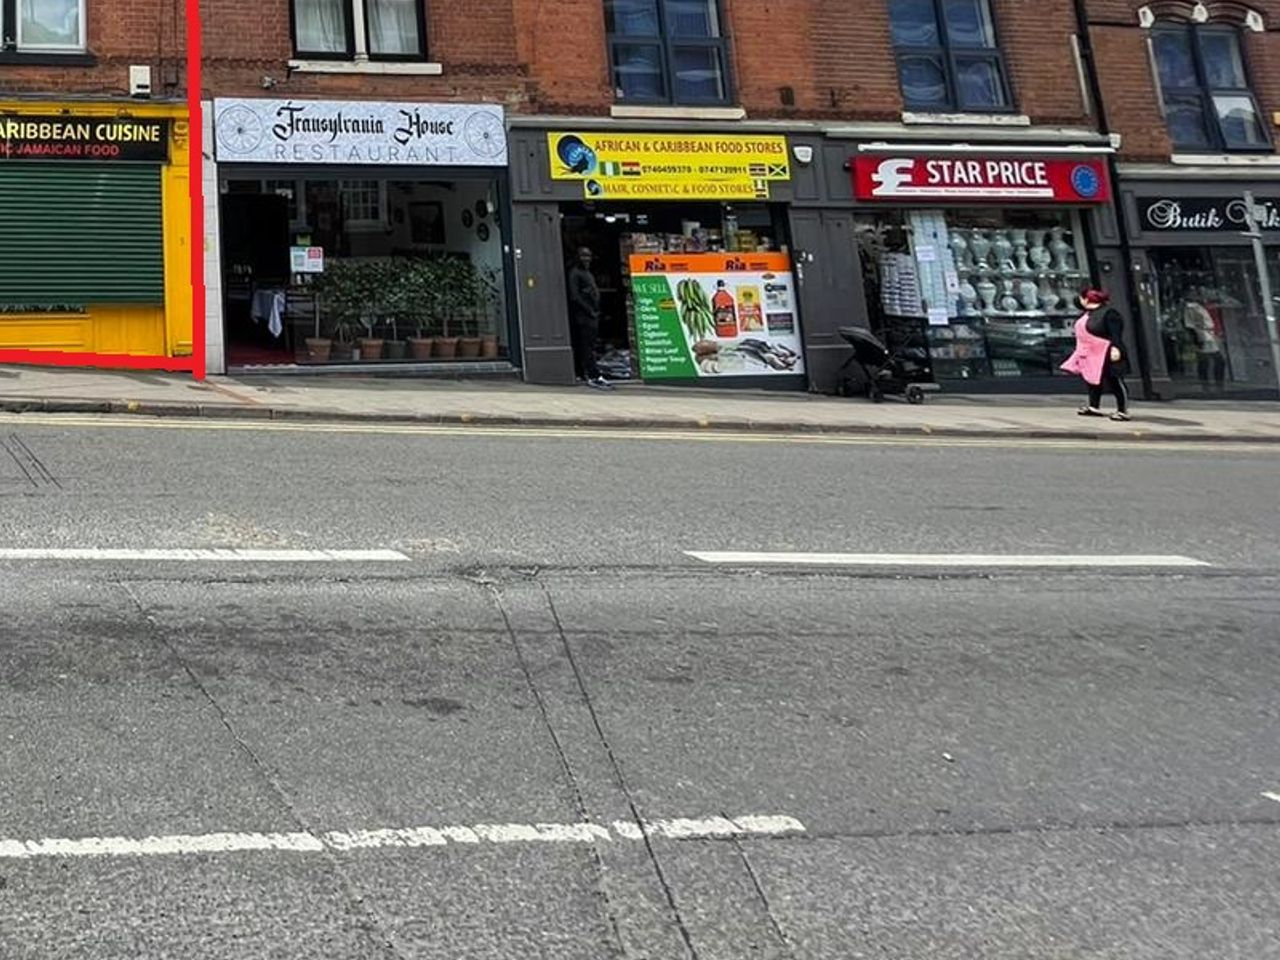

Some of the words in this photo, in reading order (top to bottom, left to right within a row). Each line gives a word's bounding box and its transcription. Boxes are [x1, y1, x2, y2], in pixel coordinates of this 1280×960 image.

[271, 101, 384, 143] Transylvania
[393, 107, 455, 146] House
[95, 123, 161, 142] CUISINE
[17, 143, 81, 155] JAMAICAN
[84, 144, 120, 156] FOOD
[274, 143, 459, 163] RESTAURANT
[595, 140, 640, 152] AFRICAN
[652, 140, 713, 153] CARIBBEAN
[715, 141, 743, 153] FOOD
[745, 142, 783, 154] STORES
[926, 160, 981, 184] STAR
[986, 161, 1048, 185] PRICE
[692, 184, 717, 194] FOOD
[720, 184, 754, 195] STORES
[1147, 199, 1224, 228] Butik
[644, 257, 666, 271] Ria
[725, 256, 747, 271] Ria
